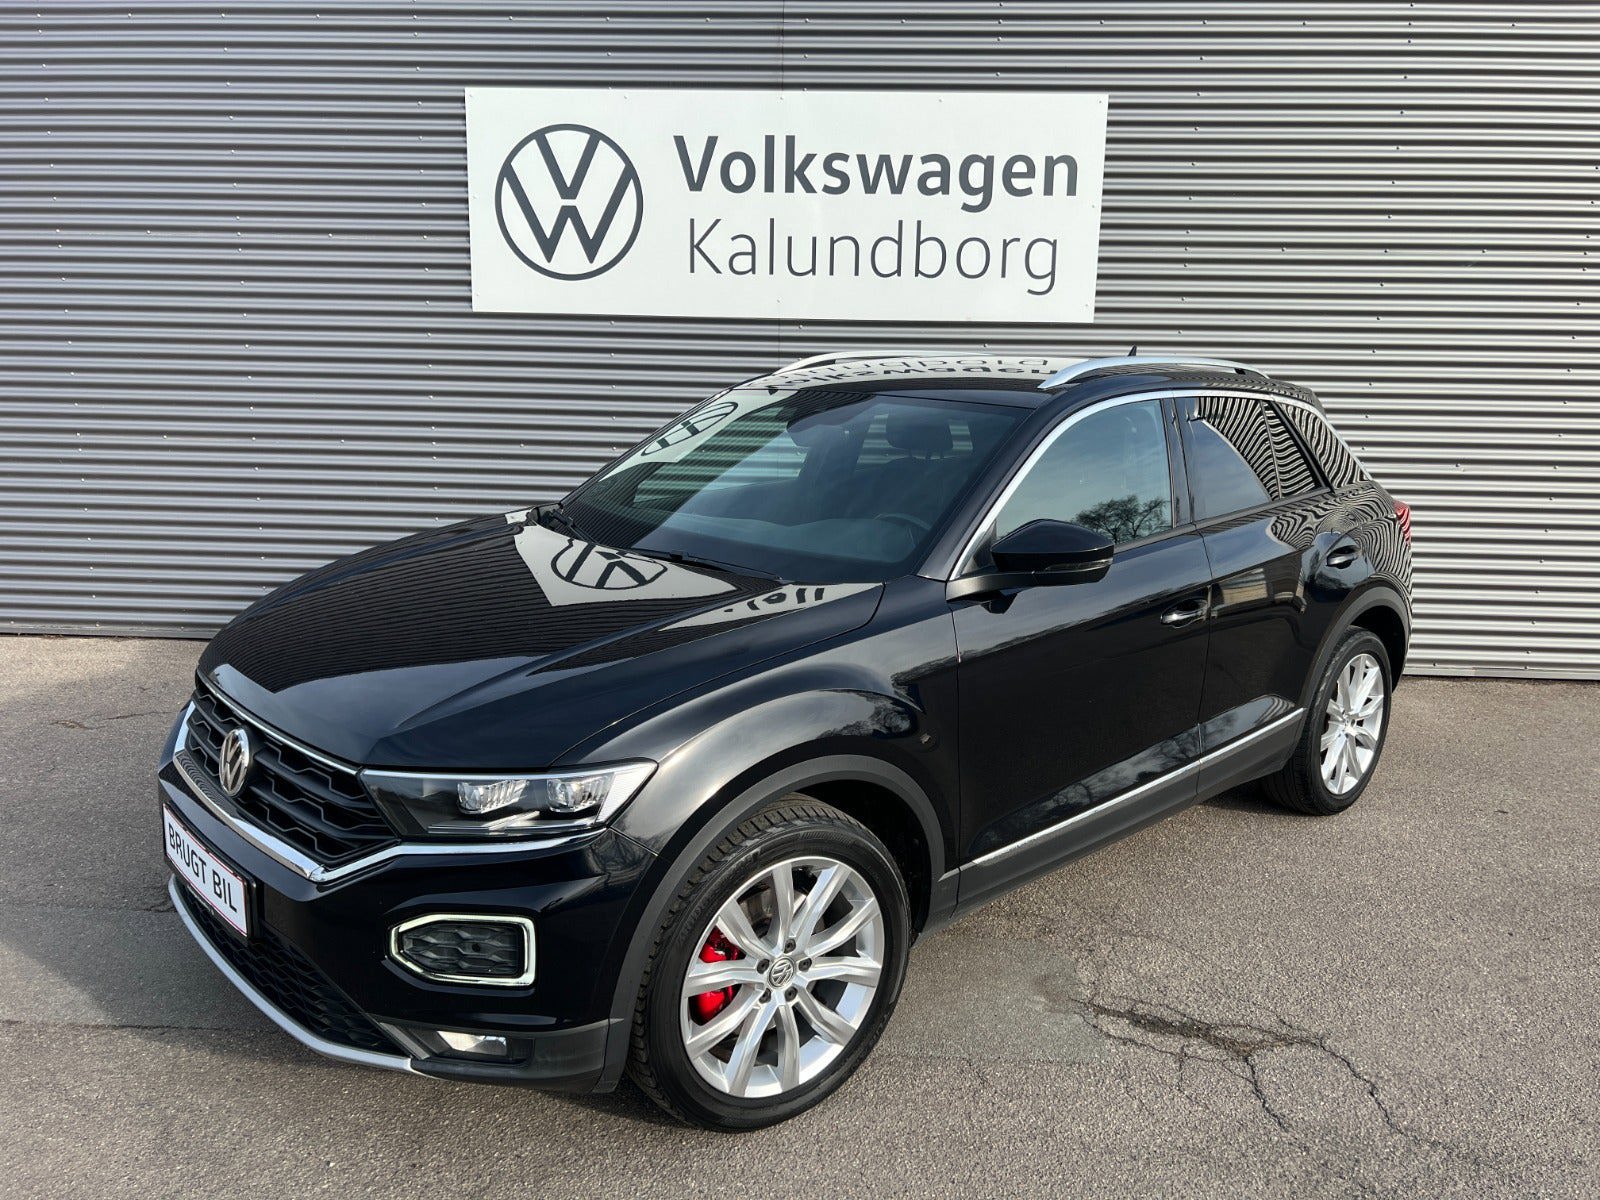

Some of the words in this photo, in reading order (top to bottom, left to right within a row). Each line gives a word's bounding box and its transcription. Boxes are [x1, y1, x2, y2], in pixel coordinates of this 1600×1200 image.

[495, 124, 644, 281] VW
[673, 134, 1078, 213] Volkswagen
[689, 217, 1058, 296] Kalundborg
[219, 728, 249, 796] VW
[168, 822, 207, 885] BRUGT
[212, 868, 238, 913] BIL
